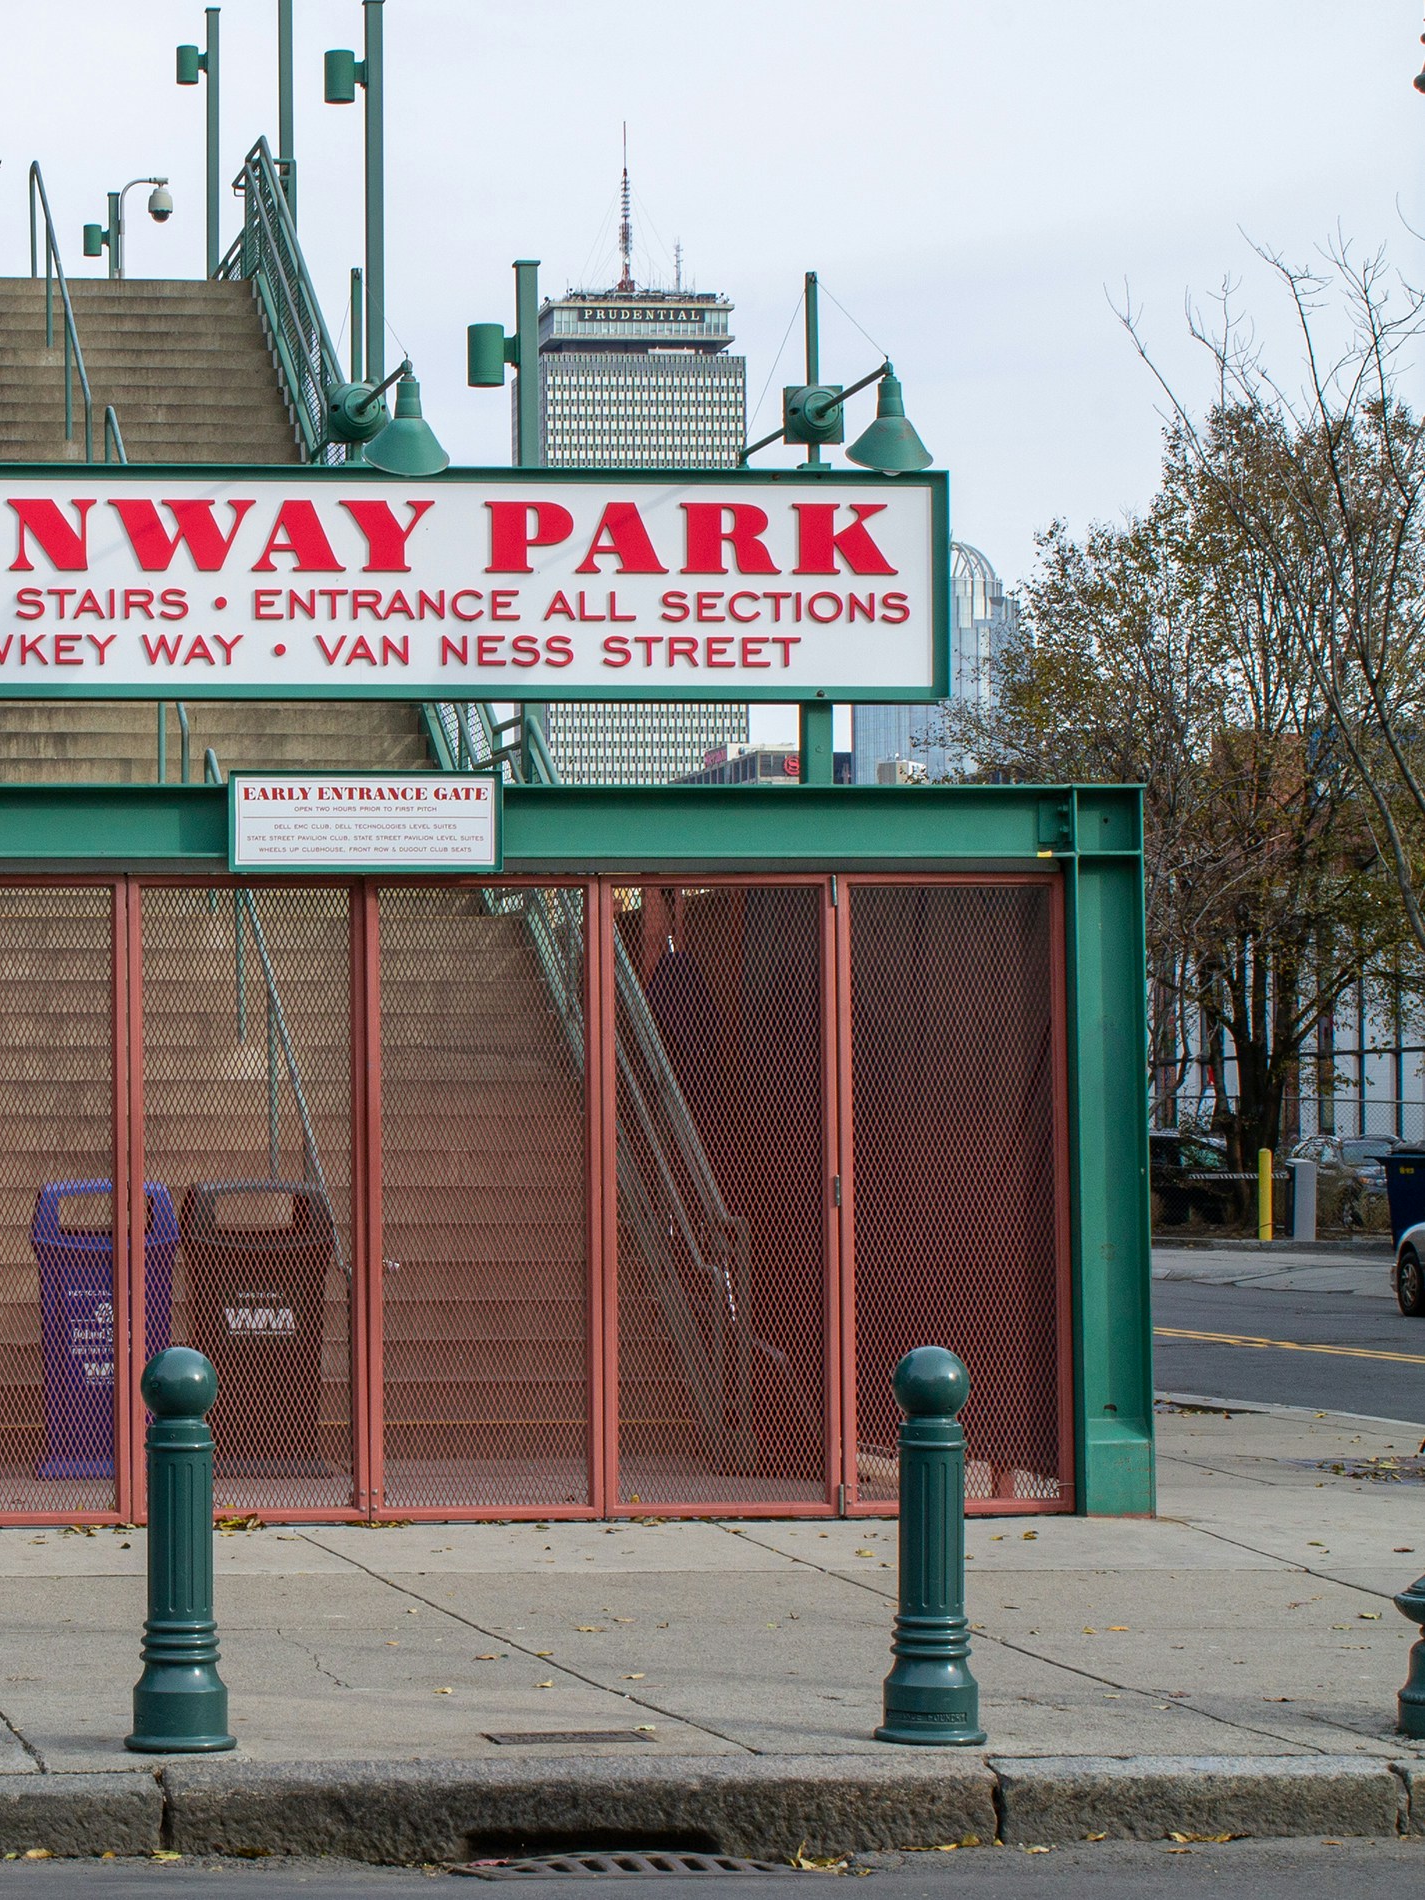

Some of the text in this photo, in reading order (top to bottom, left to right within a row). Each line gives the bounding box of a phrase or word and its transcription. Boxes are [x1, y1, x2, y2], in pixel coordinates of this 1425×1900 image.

[584, 309, 700, 320] PRUDENTIAL
[483, 501, 899, 576] PARK
[15, 587, 189, 621] STAIRS
[254, 588, 521, 622] ENTRANCE
[543, 590, 637, 622] ALL
[661, 590, 911, 624] SECTIONS
[141, 633, 244, 666] WAY
[316, 634, 410, 667] VAN
[441, 635, 575, 668] NESS
[602, 636, 802, 668] STREET
[243, 786, 488, 801] EARLY ENTRANCE GATE
